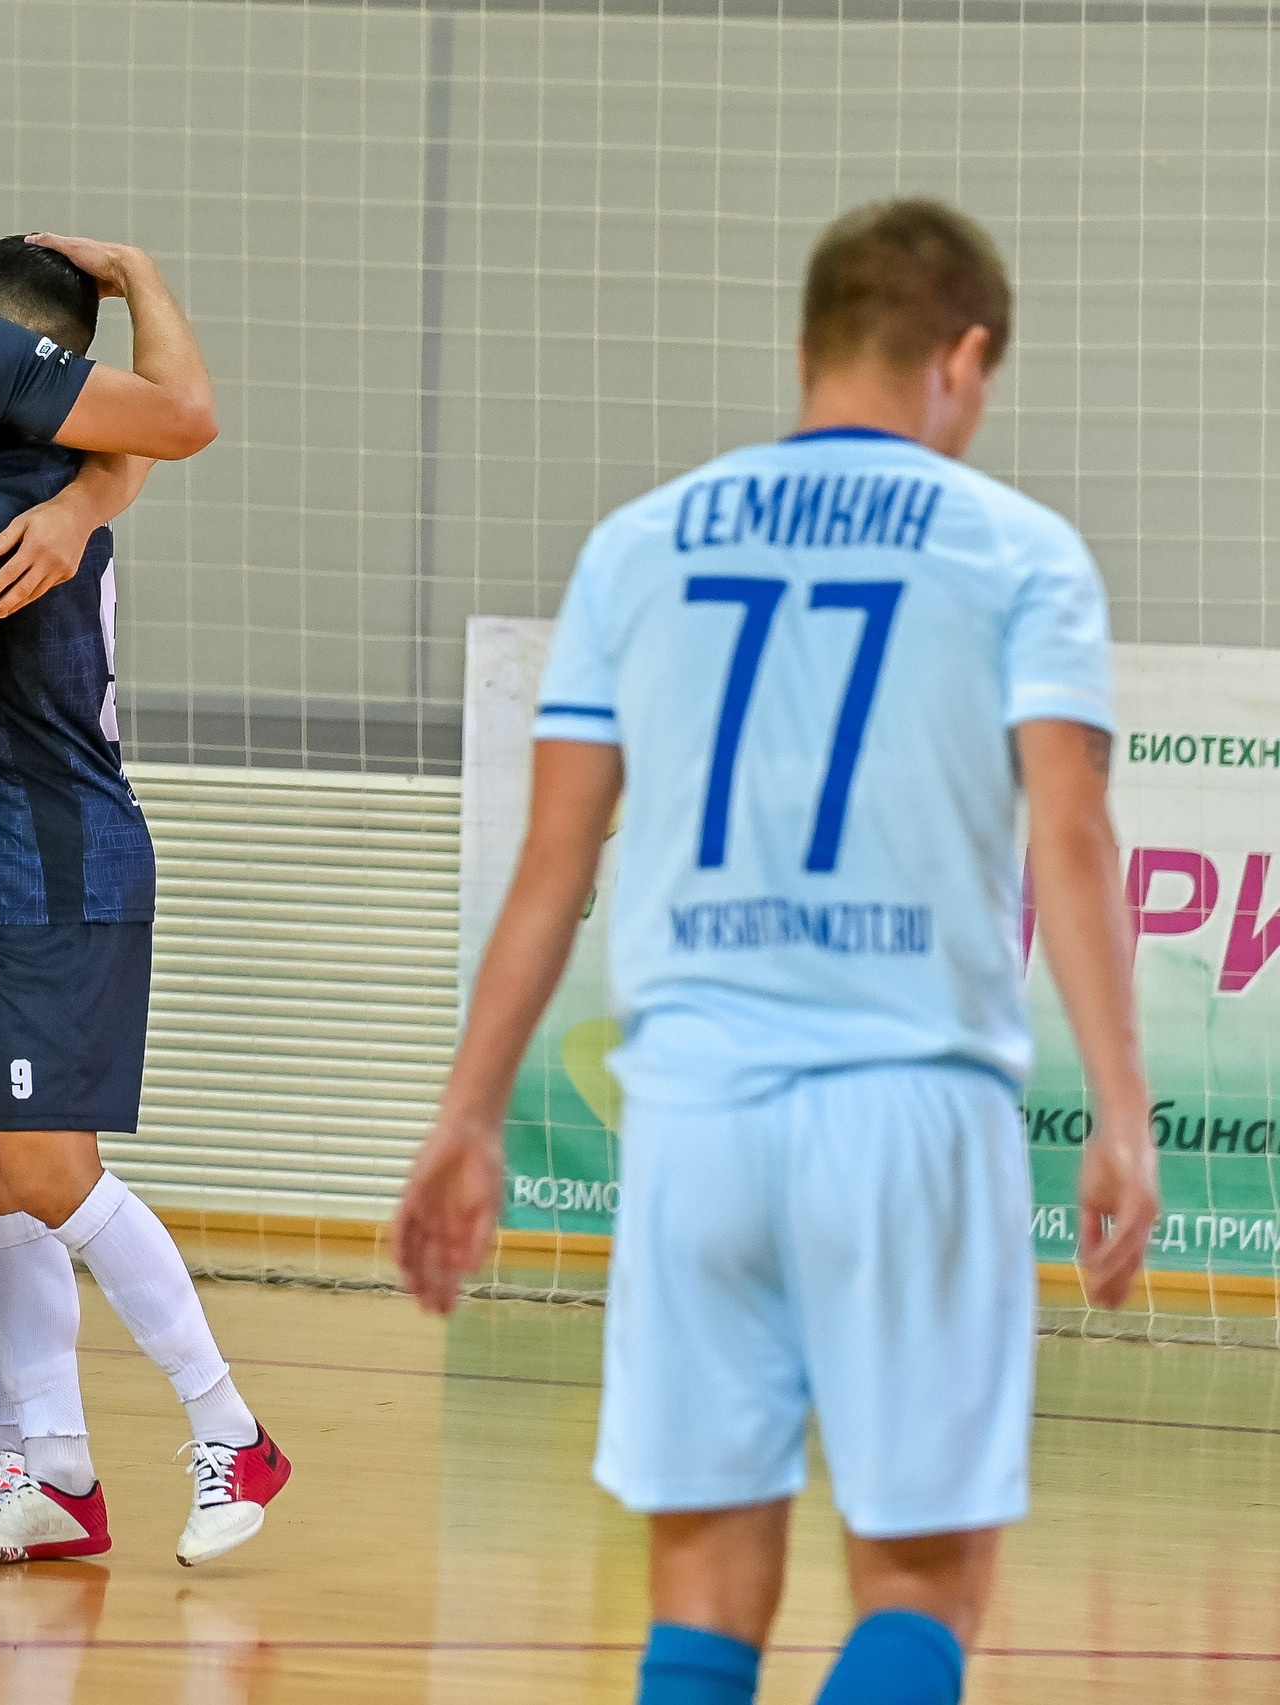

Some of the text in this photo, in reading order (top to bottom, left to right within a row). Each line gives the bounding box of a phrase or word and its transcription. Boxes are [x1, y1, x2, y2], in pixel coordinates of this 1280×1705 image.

[674, 474, 943, 552] СЕМИКИН
[684, 574, 904, 873] 77
[10, 1059, 33, 1100] 9
